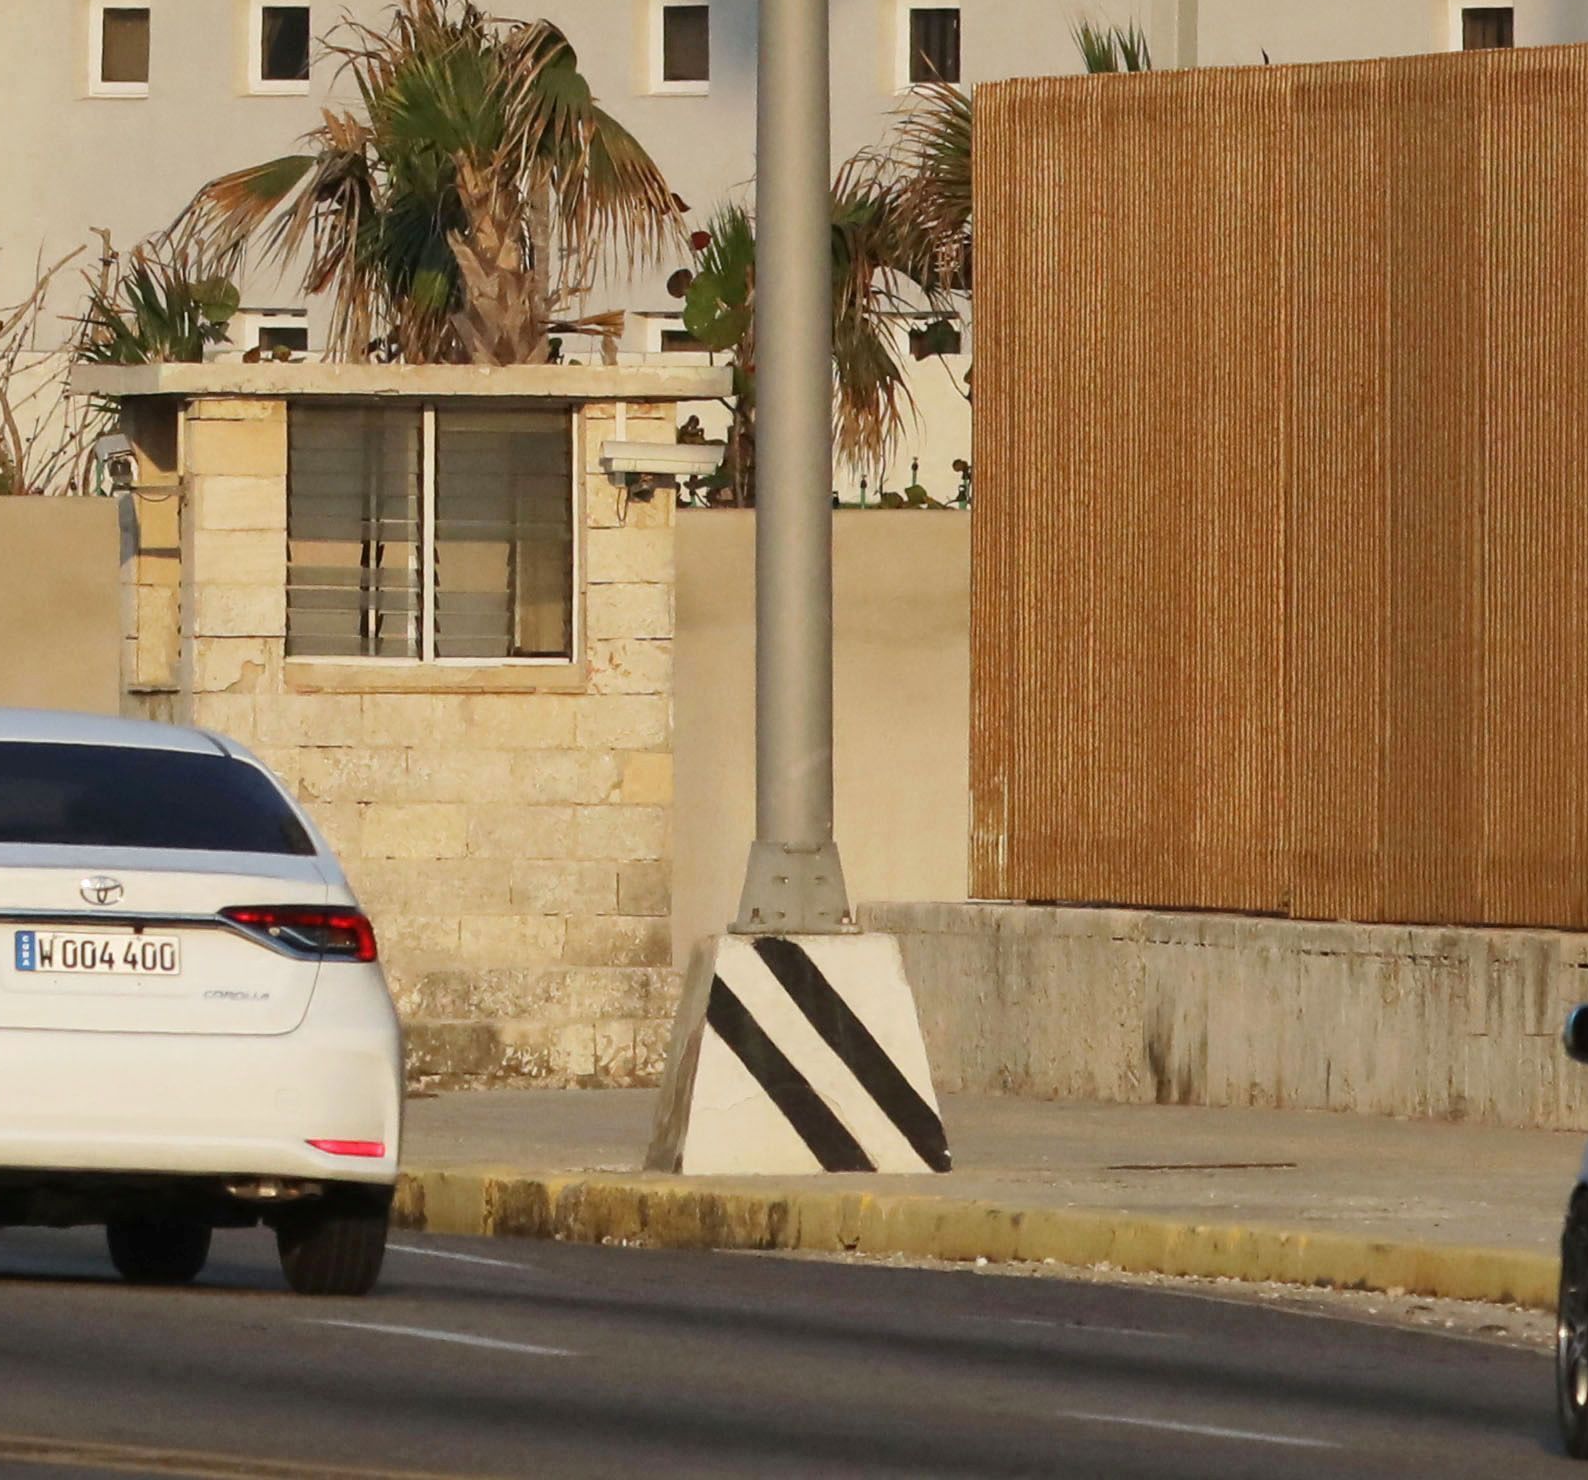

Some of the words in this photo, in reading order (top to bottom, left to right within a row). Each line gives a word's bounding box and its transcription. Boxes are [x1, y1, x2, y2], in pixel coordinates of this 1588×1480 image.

[39, 938, 54, 968] W
[62, 939, 116, 971] 004
[123, 941, 175, 972] 400
